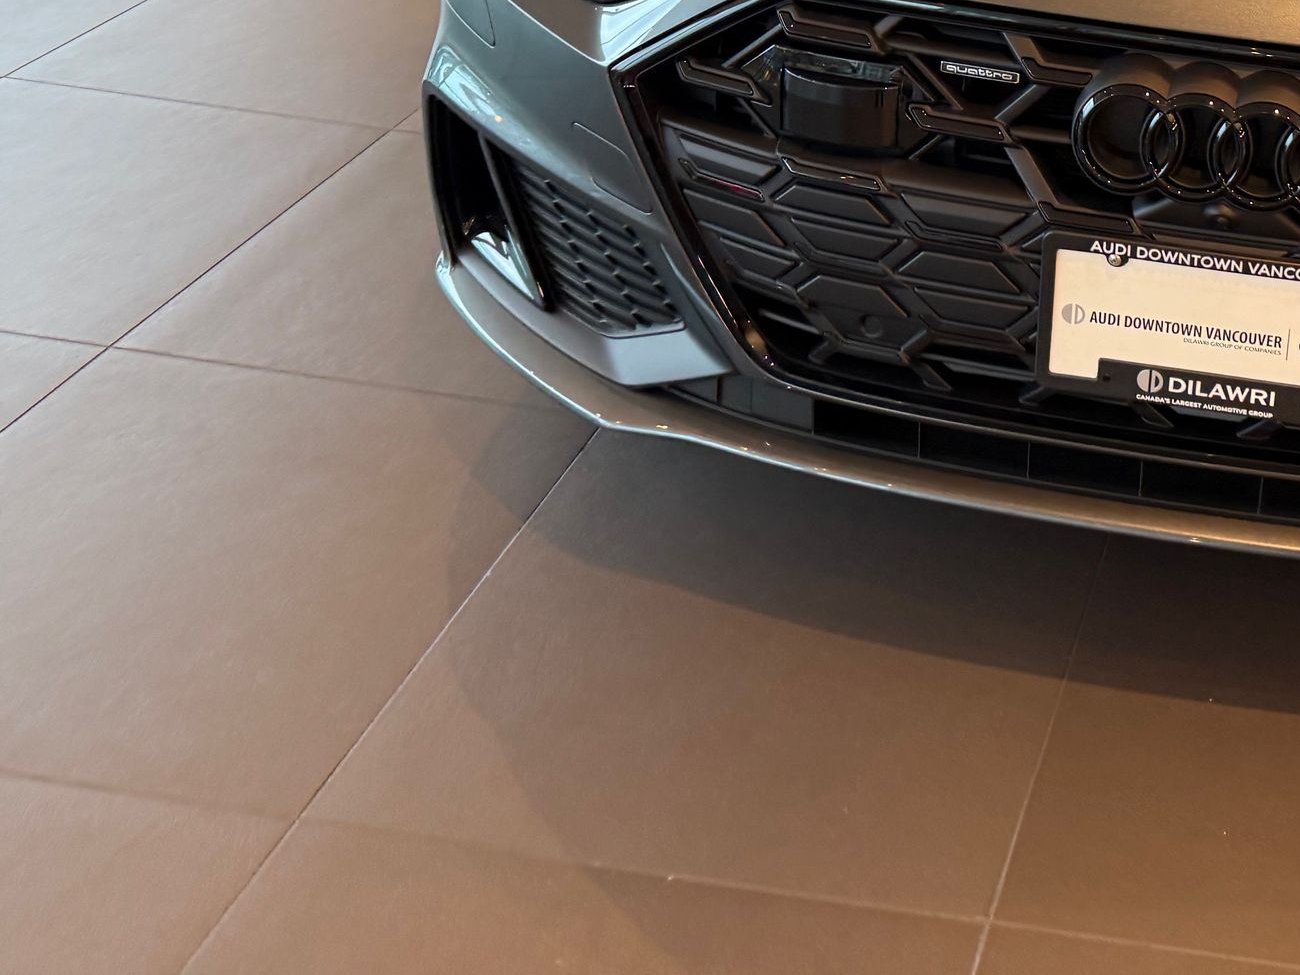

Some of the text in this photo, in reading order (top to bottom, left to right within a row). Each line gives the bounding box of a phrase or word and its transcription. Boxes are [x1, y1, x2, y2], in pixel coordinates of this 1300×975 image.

[945, 64, 1013, 81] quattro
[1090, 240, 1132, 257] AUDI
[1136, 246, 1244, 273] DOWNTOWN
[1089, 311, 1283, 349] AUDI DOWNTOWN VANCOUVER
[1183, 337, 1210, 346] DILAWRI
[1210, 340, 1233, 349] GROUP
[1244, 345, 1283, 356] COMPANIES
[1135, 393, 1274, 419] CANADA'S LARGEST AUTOMOTIVE GROUP
[1167, 376, 1277, 408] DILAWRI
